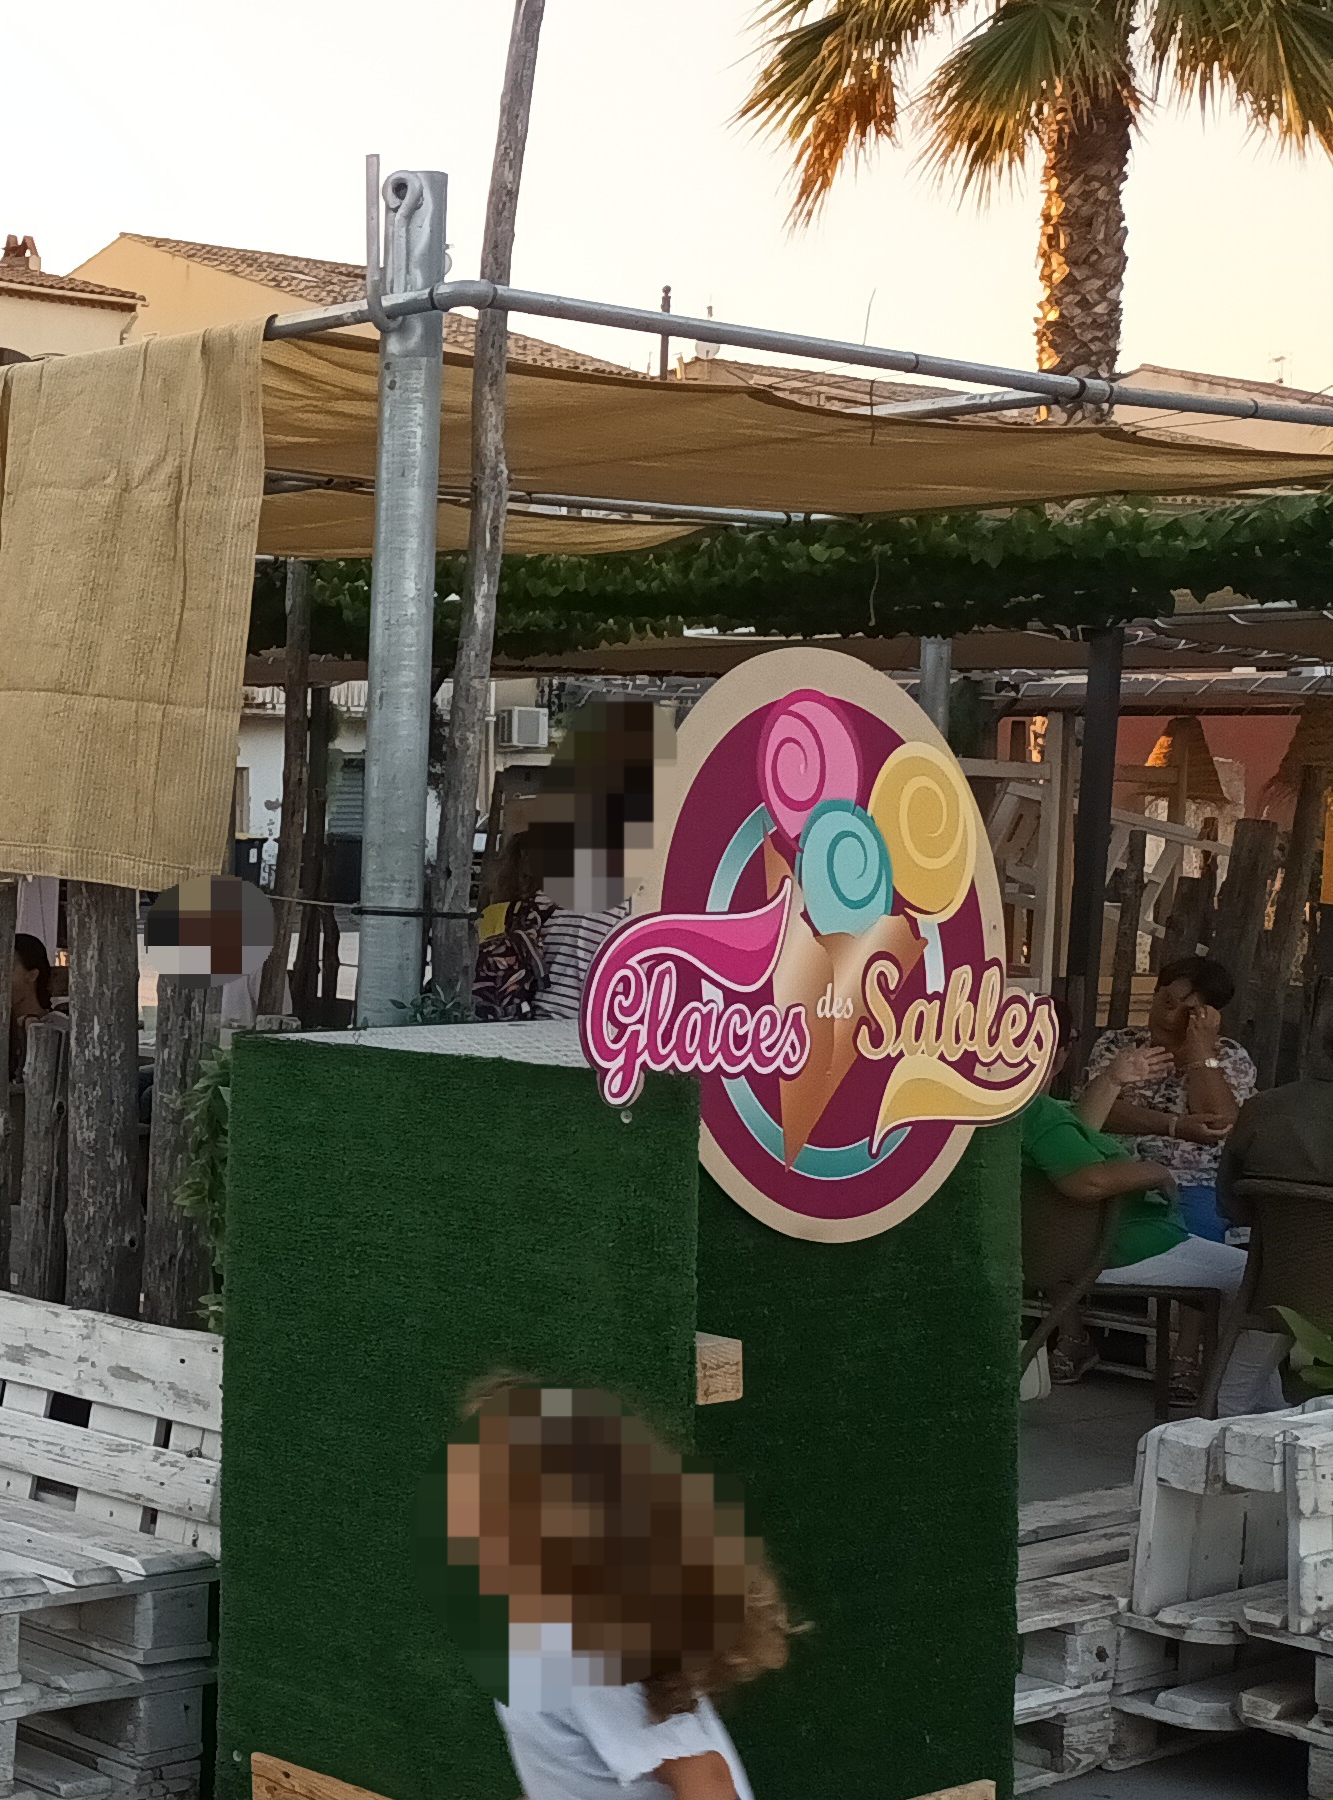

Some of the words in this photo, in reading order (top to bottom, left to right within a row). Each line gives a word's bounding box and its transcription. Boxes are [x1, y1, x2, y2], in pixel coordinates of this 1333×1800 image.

[588, 945, 812, 1106] Glaces
[815, 990, 855, 1021] des
[855, 952, 1059, 1080] Sables
